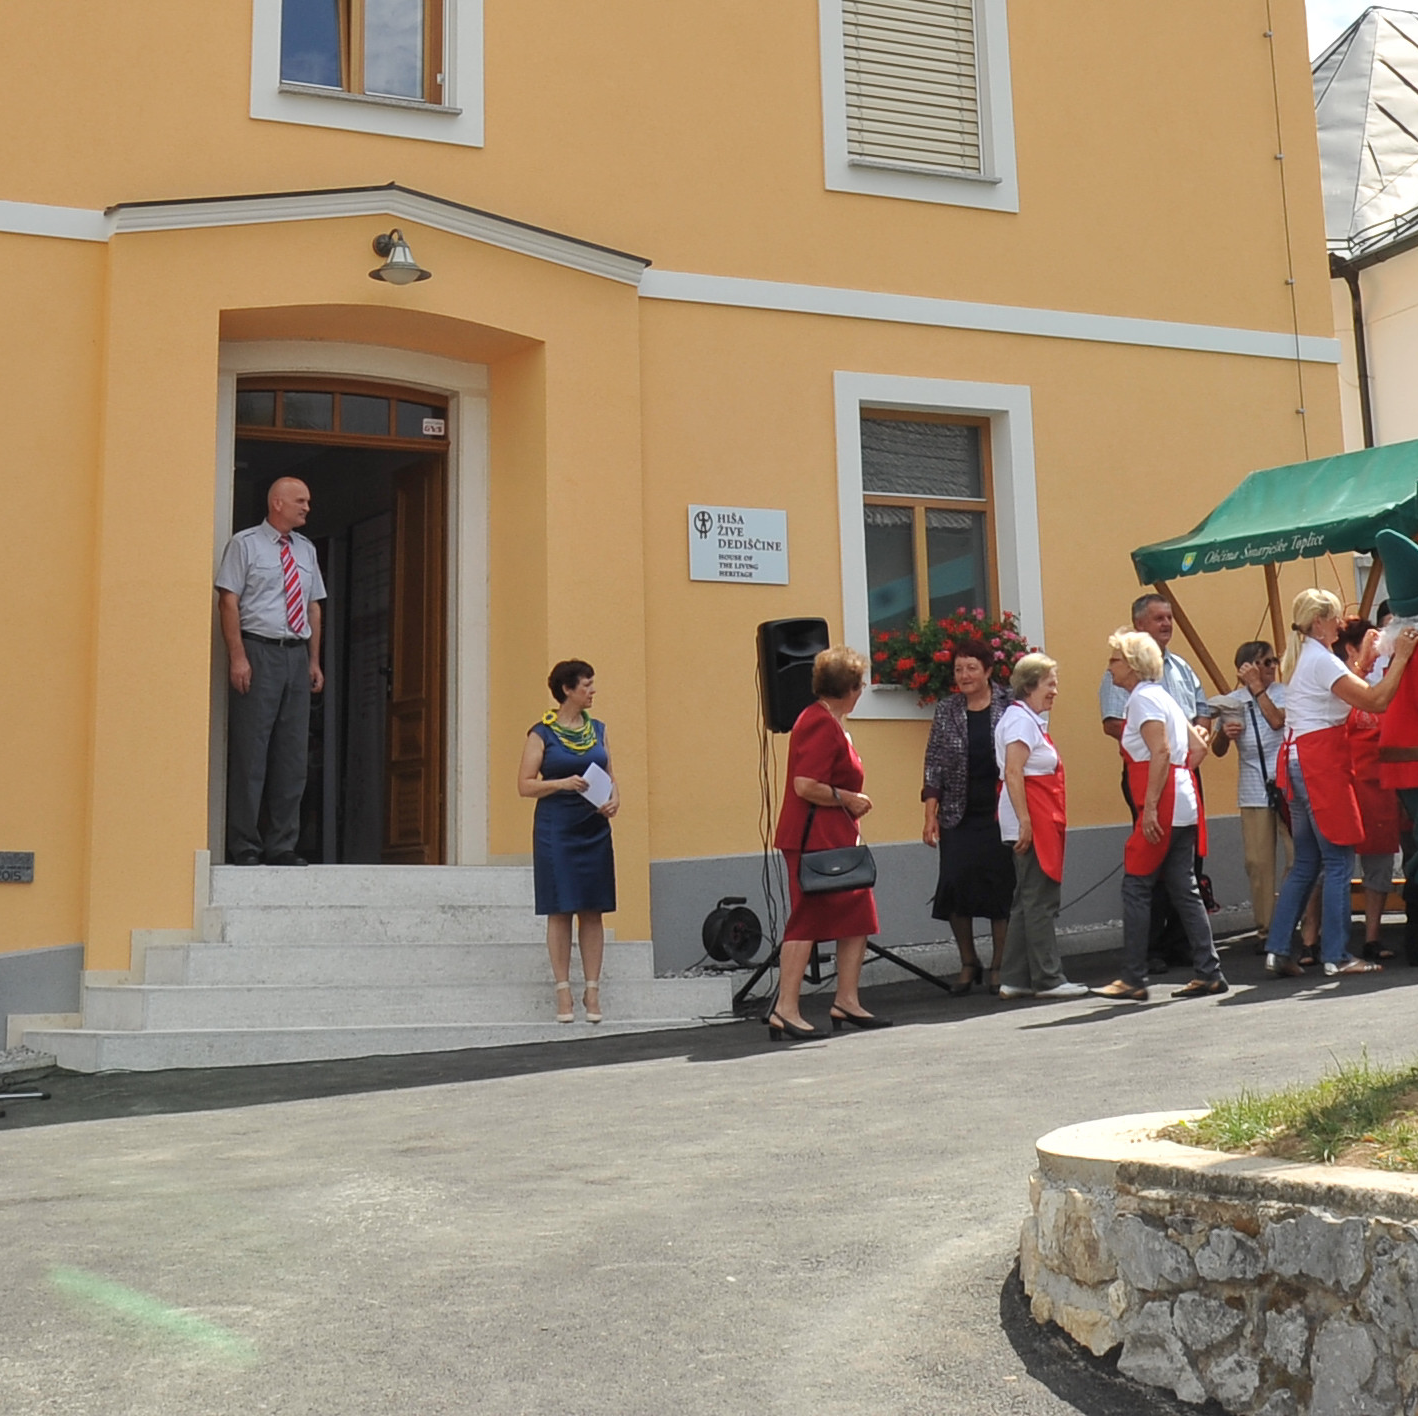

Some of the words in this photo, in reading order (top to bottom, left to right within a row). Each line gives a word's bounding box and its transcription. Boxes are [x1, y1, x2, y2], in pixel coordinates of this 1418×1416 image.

[717, 512, 744, 524] HIŠA
[717, 524, 744, 537] ŽIVE
[718, 538, 782, 551] DEDIŠČINE
[1203, 549, 1239, 564] Občina
[1240, 538, 1288, 560] Šmarješke
[1290, 531, 1325, 554] Toplice
[734, 562, 759, 570] LIVING
[719, 570, 753, 578] HERITAGE
